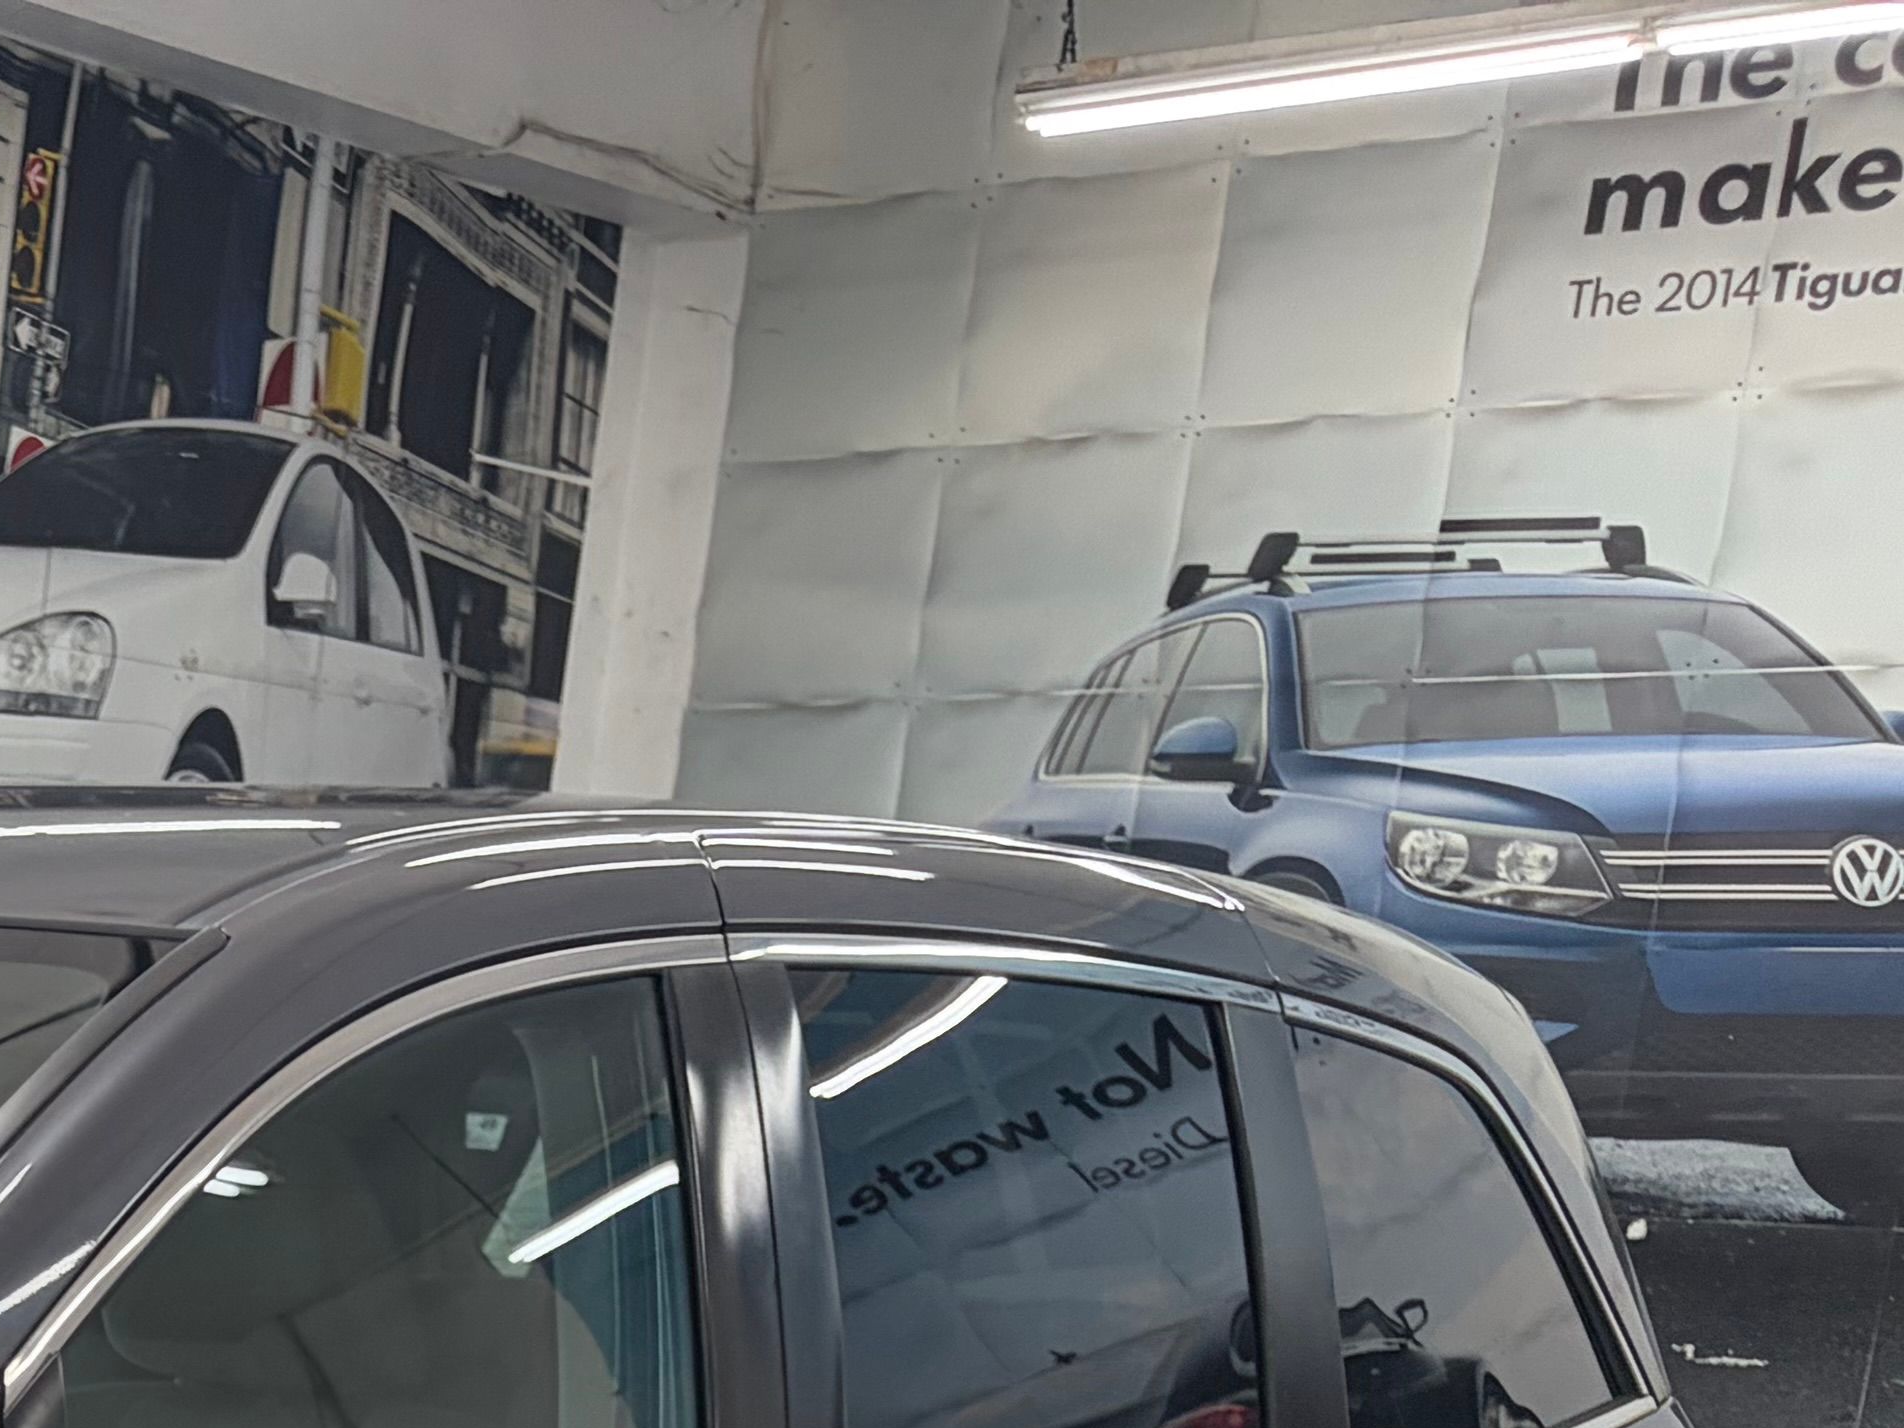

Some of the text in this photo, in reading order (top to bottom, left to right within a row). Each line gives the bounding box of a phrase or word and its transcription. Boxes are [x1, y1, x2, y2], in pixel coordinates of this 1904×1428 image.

[1835, 33, 1904, 87] c
[1583, 117, 1903, 235] make
[1569, 260, 1904, 319] The 2014 Tigua
